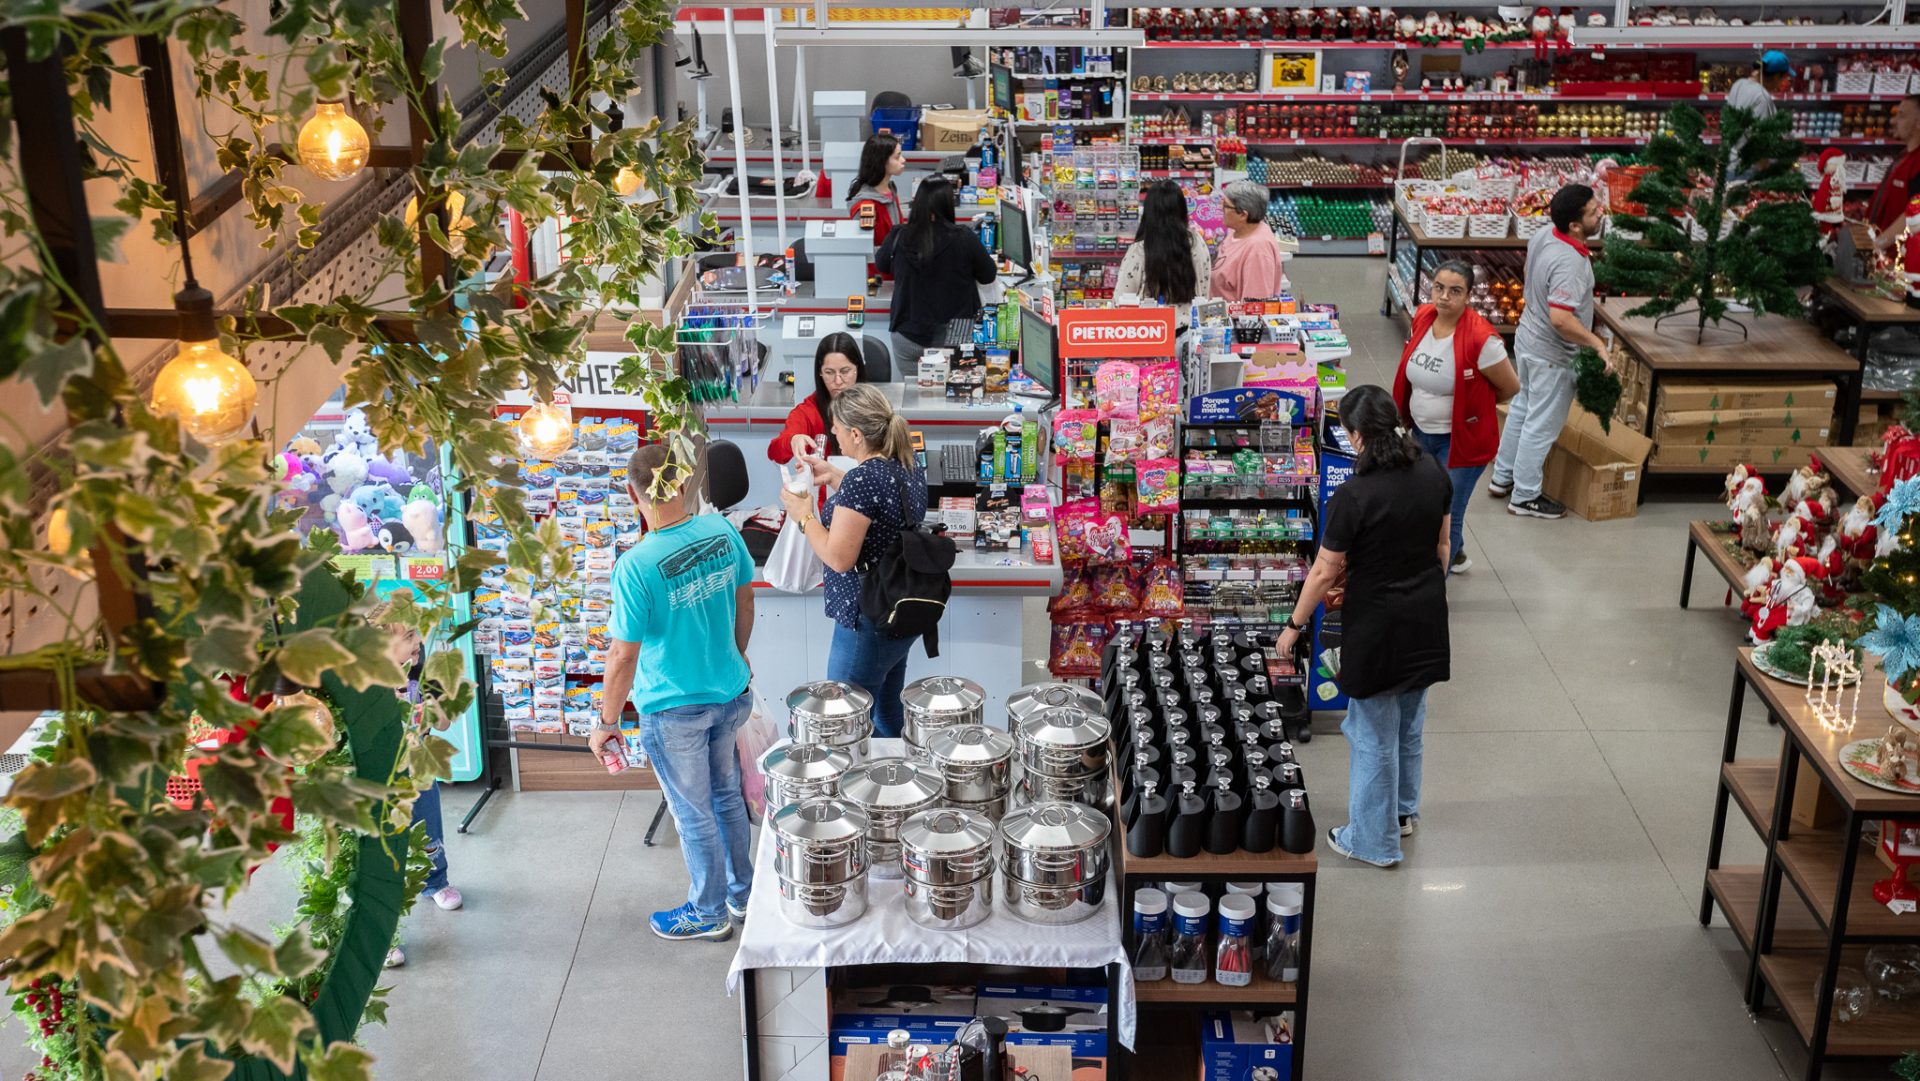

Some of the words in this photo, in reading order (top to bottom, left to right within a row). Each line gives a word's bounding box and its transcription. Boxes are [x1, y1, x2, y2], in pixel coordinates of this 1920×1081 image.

[1072, 325, 1162, 340] PIETROBON
[1202, 397, 1230, 405] Porque
[1327, 465, 1354, 476] Porqu
[416, 566, 439, 575] 2,00
